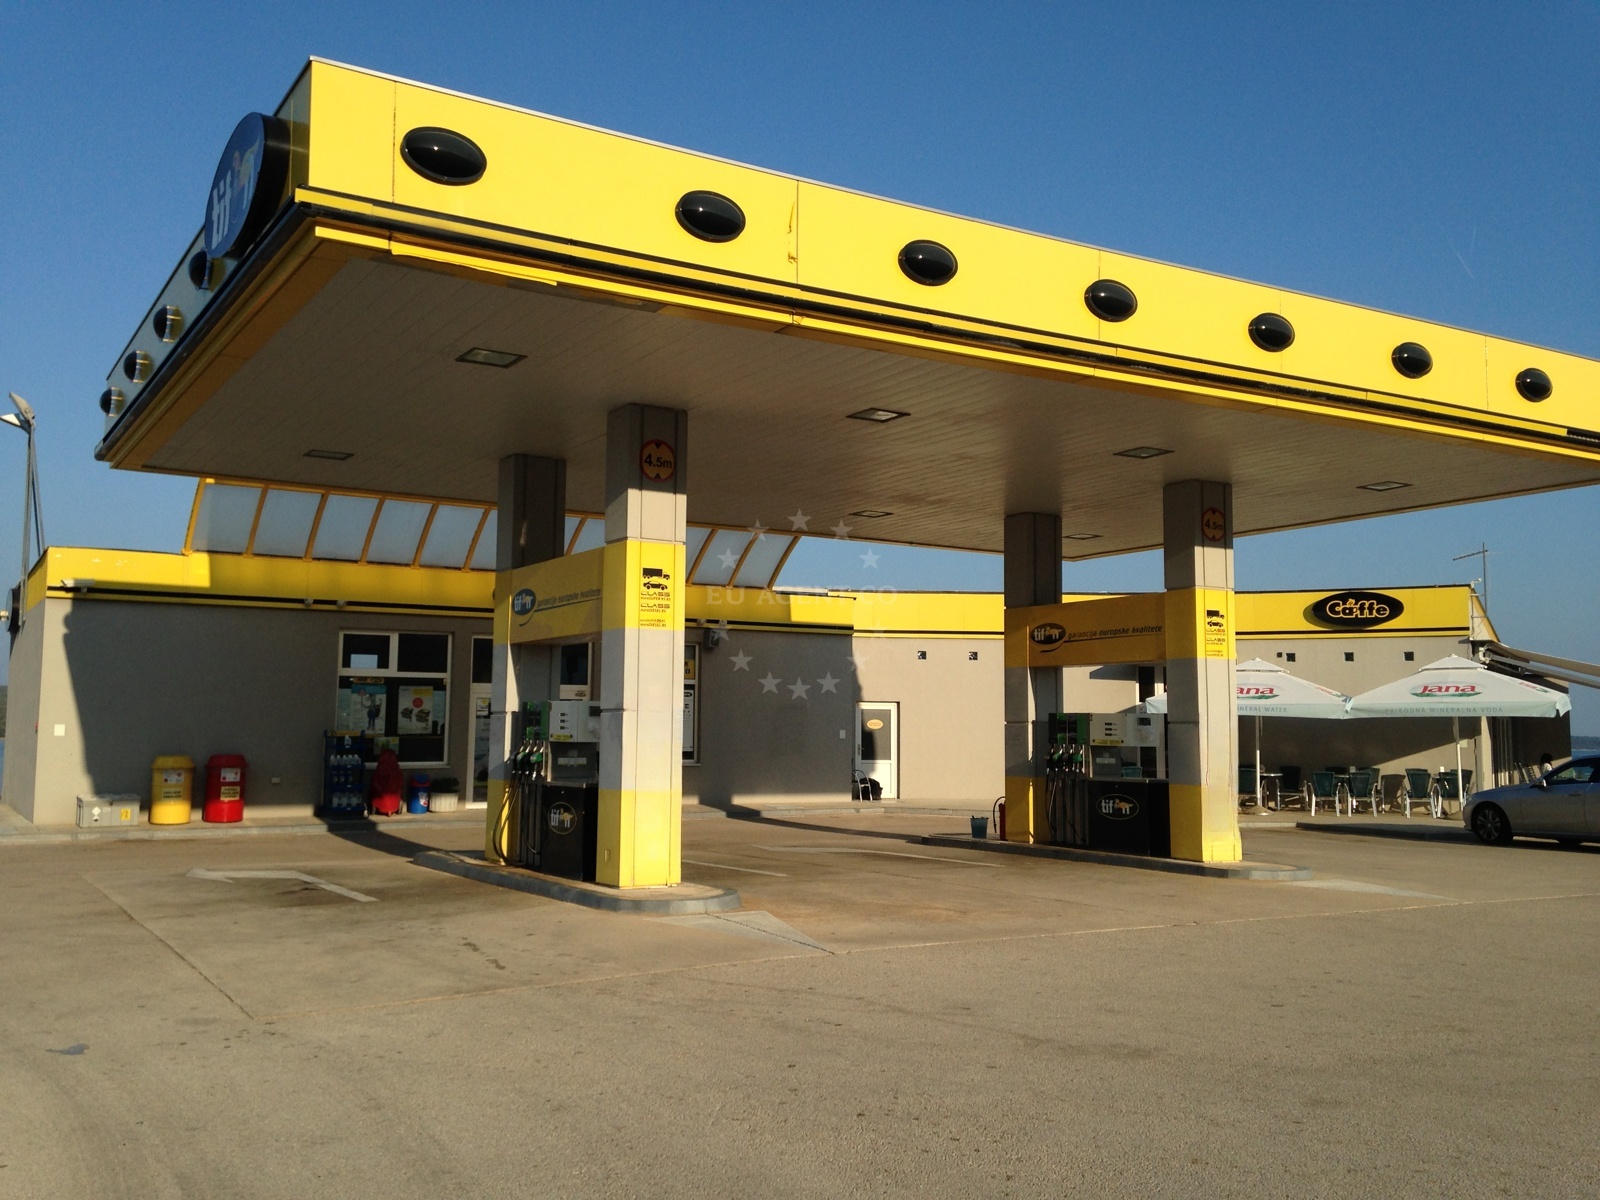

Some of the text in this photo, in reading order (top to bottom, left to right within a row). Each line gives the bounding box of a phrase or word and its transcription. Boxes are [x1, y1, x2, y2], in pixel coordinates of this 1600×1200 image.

[644, 453, 673, 469] 4.5m
[1204, 518, 1224, 531] 4.5m
[1326, 600, 1389, 618] Caffe
[1068, 630, 1097, 640] garancija
[1099, 627, 1130, 637] europske
[1131, 625, 1163, 634] kvalitete
[1237, 687, 1275, 695] ana
